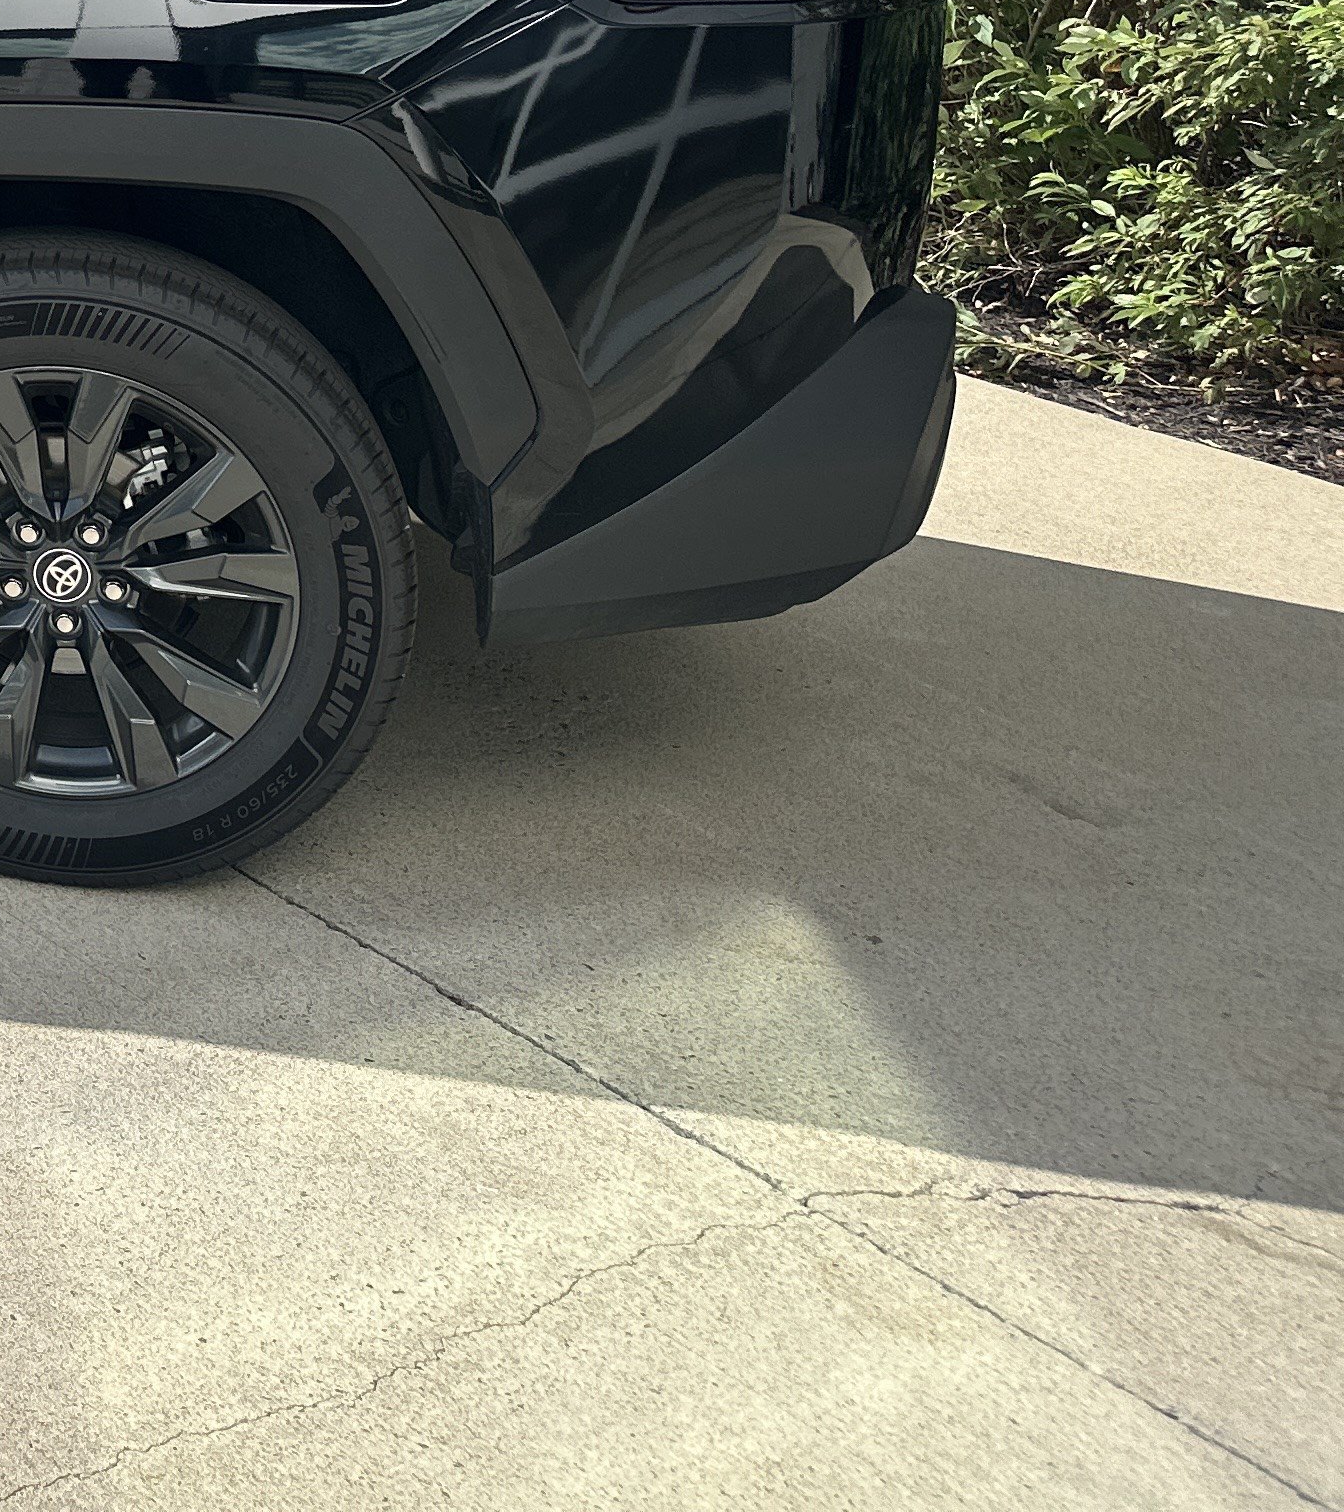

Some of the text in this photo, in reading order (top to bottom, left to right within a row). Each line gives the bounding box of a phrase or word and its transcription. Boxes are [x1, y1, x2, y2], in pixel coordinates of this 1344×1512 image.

[316, 543, 375, 741] MICHELIN
[237, 763, 299, 819] 235/60
[192, 825, 215, 842] 18
